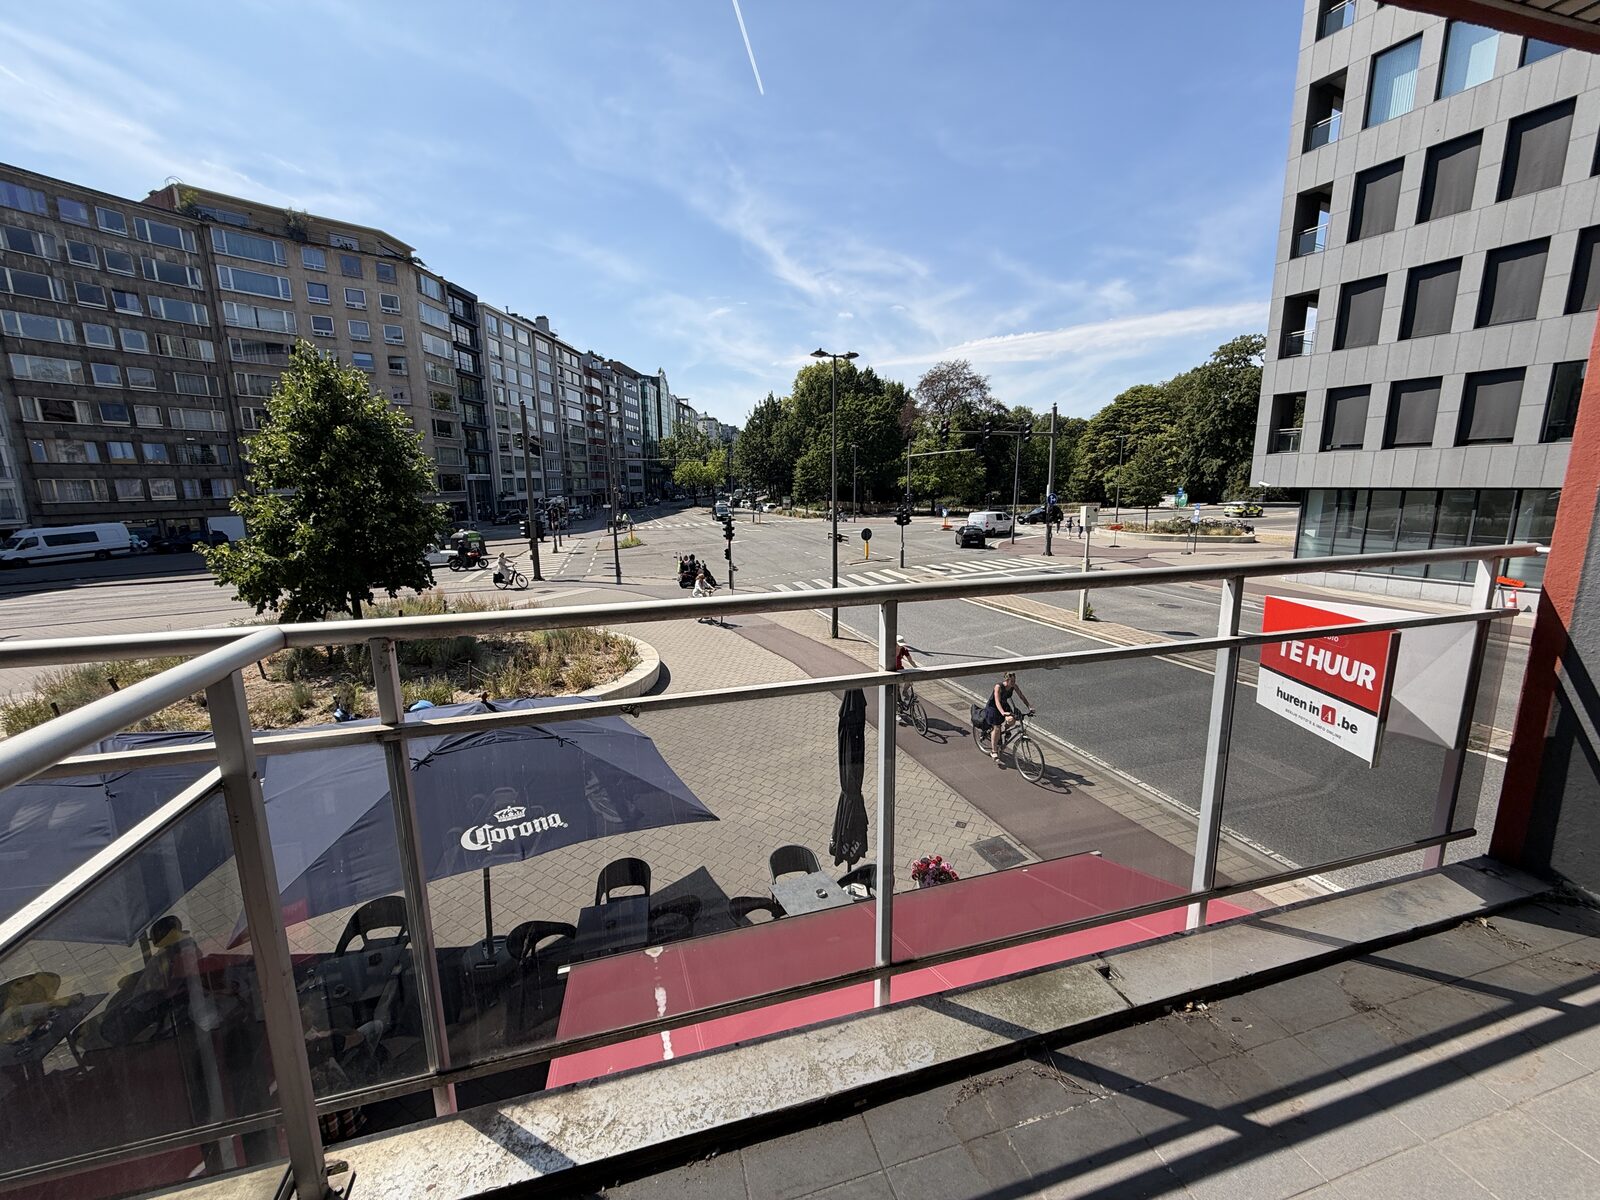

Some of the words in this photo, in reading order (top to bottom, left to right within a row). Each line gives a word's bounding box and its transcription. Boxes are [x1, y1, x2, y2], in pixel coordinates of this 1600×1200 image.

[1280, 640, 1305, 663] TE
[1305, 645, 1376, 691] HUUR
[1276, 686, 1307, 710] huren
[1308, 701, 1320, 717] in
[460, 813, 565, 851] Corona
